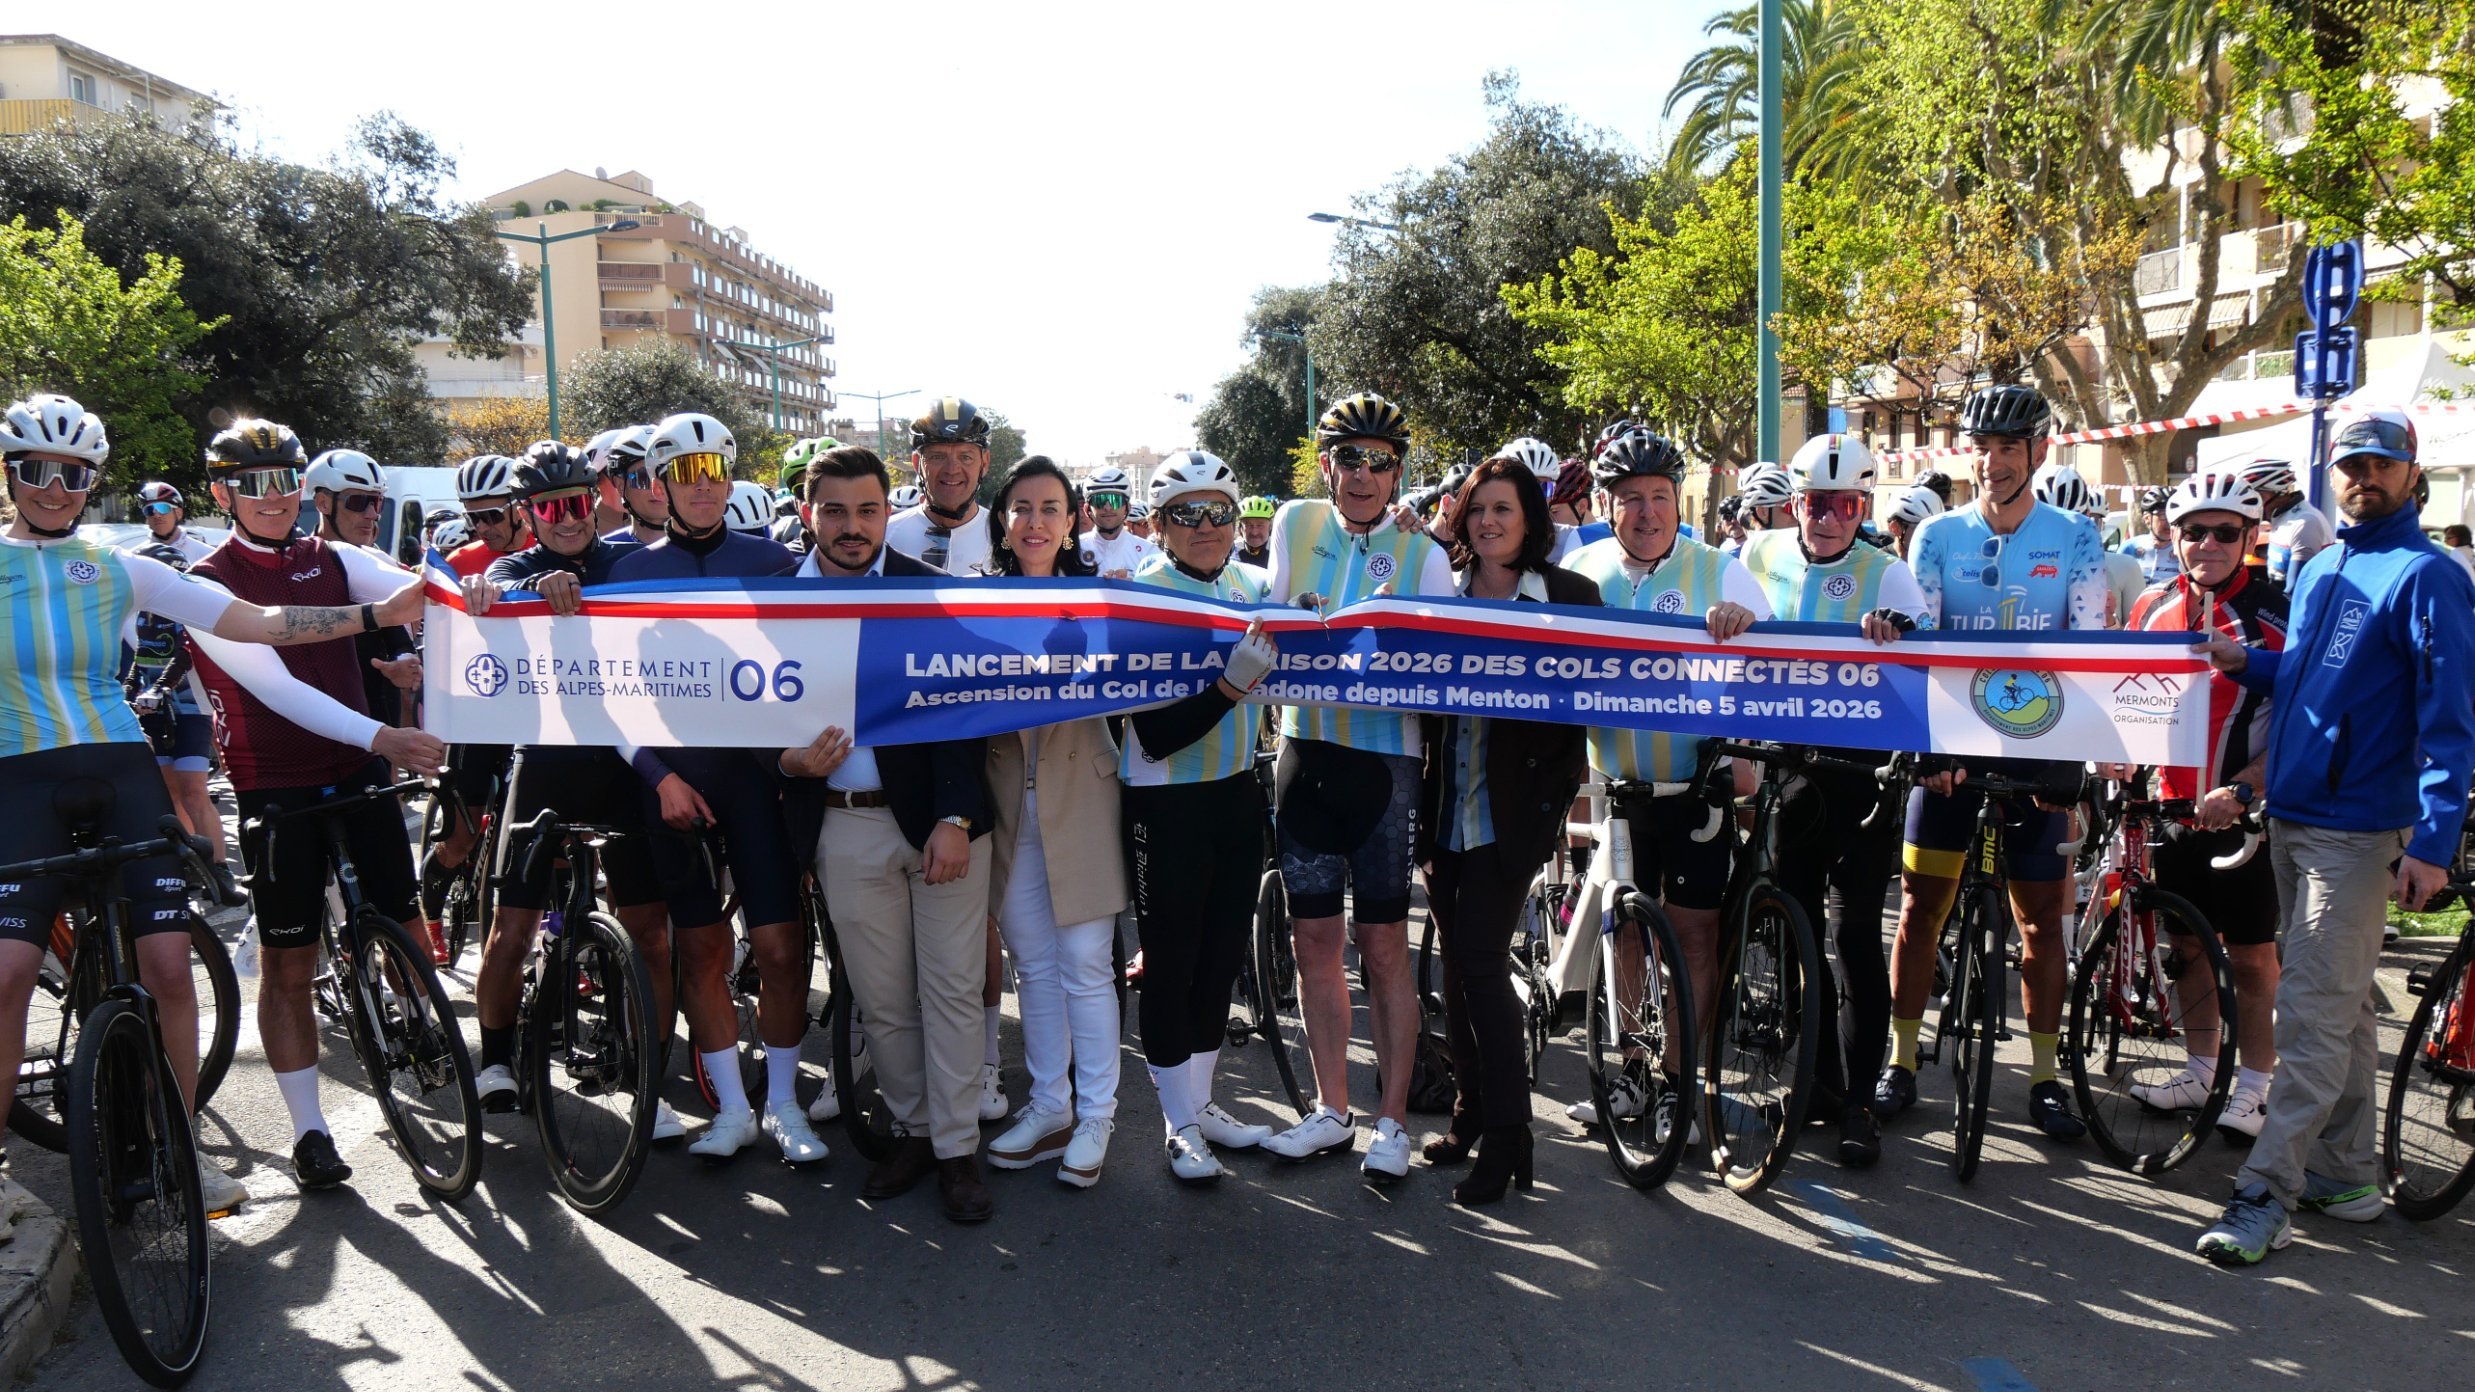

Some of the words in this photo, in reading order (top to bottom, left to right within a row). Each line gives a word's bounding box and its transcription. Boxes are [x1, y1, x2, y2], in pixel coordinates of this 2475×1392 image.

[2028, 551, 2060, 560] SOMAT
[1980, 606, 1992, 614] LA
[516, 654, 711, 678] DÉPARTEMENT
[905, 653, 1119, 677] LANCEMENT
[1128, 652, 1172, 671] DE
[1181, 650, 1225, 670] LA
[1270, 652, 1362, 671] ISON
[1369, 651, 1453, 673] 2026
[1461, 654, 1527, 676] DES
[1535, 656, 1621, 680] COLS
[1629, 657, 1829, 686] CONNECTÉS
[1837, 663, 1880, 687] 06
[518, 681, 549, 695] DES
[556, 681, 711, 698] ALPES-MARITIMES
[730, 659, 804, 702] 06
[905, 684, 1051, 709] Ascension
[1058, 681, 1095, 700] du
[1102, 680, 1147, 699] Col
[1154, 680, 1188, 698] de
[1251, 679, 1338, 701] adone
[1346, 682, 1438, 707] depuis
[1446, 686, 1550, 709] Menton
[1574, 691, 1712, 715] Dimanche
[1719, 696, 1736, 715] 5
[1743, 696, 1804, 718] avril
[1811, 699, 1882, 719] 2026
[2115, 695, 2179, 708] MERMONTS
[2113, 714, 2179, 726] ORGANISATION
[1406, 808, 1417, 889] VALBERG
[1981, 825, 1997, 875] BMC
[153, 909, 179, 921] DT
[2121, 909, 2130, 989] LOOK
